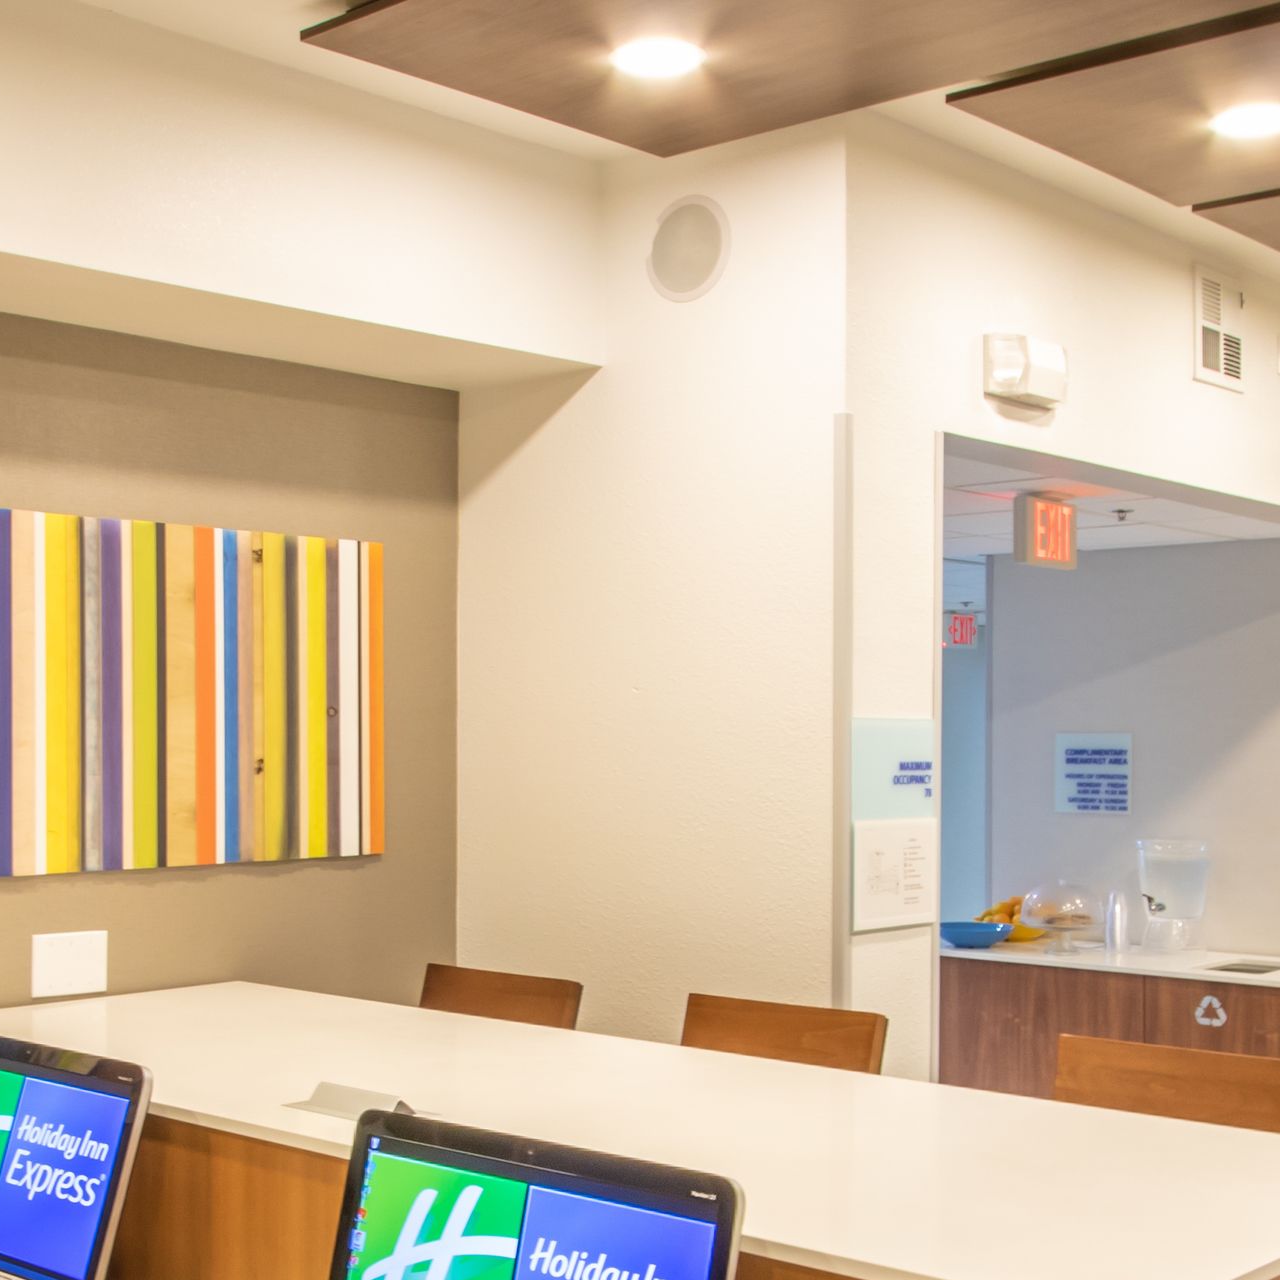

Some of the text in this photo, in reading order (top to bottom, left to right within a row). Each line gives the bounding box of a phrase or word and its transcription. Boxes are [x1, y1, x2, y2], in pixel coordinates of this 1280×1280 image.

[1034, 501, 1072, 562] EXIT
[952, 614, 975, 644] EXIT
[893, 775, 931, 785] OCCUPANCY
[899, 761, 932, 771] MAXIMUM
[17, 1114, 109, 1162] Holiday Inn
[6, 1148, 101, 1207] Express
